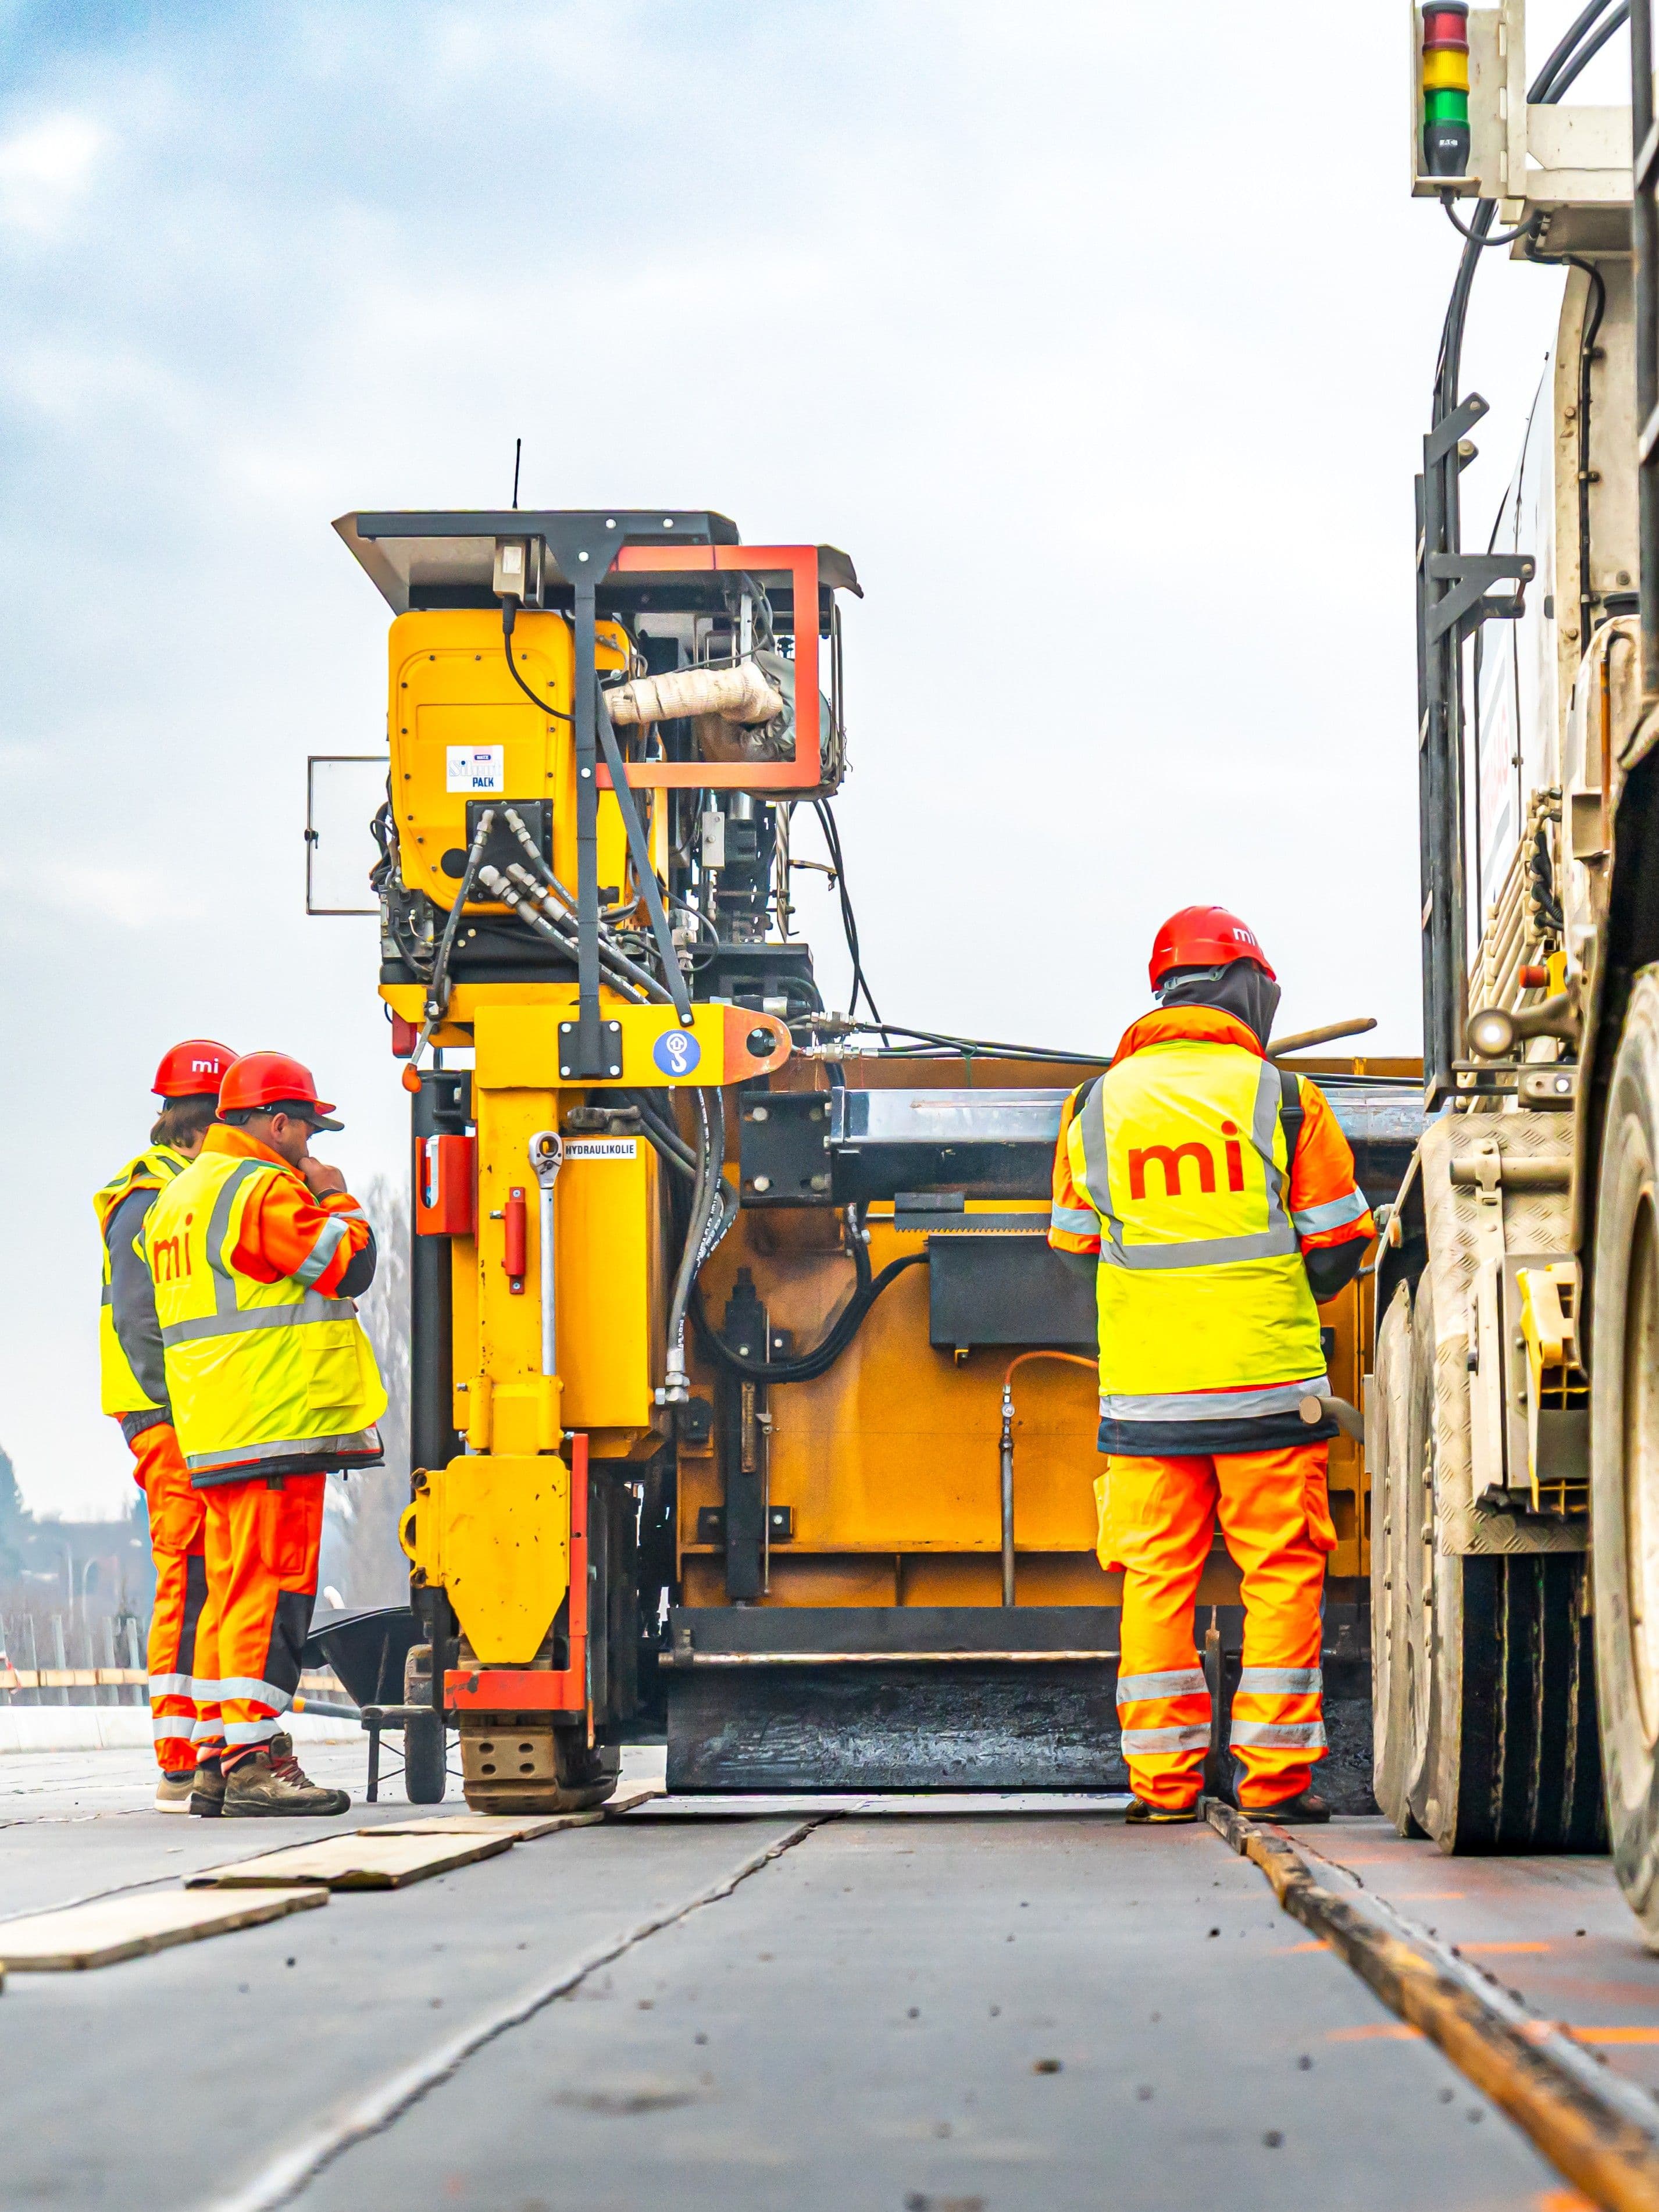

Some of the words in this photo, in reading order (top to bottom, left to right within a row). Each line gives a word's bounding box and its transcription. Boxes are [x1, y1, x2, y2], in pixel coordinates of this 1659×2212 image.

[472, 777, 494, 787] PACK
[1232, 927, 1256, 946] mi
[192, 1058, 219, 1074] mi
[566, 1144, 634, 1155] HYDRAULIKOLIE
[1128, 1120, 1245, 1200] mi
[154, 1212, 193, 1284] mi
